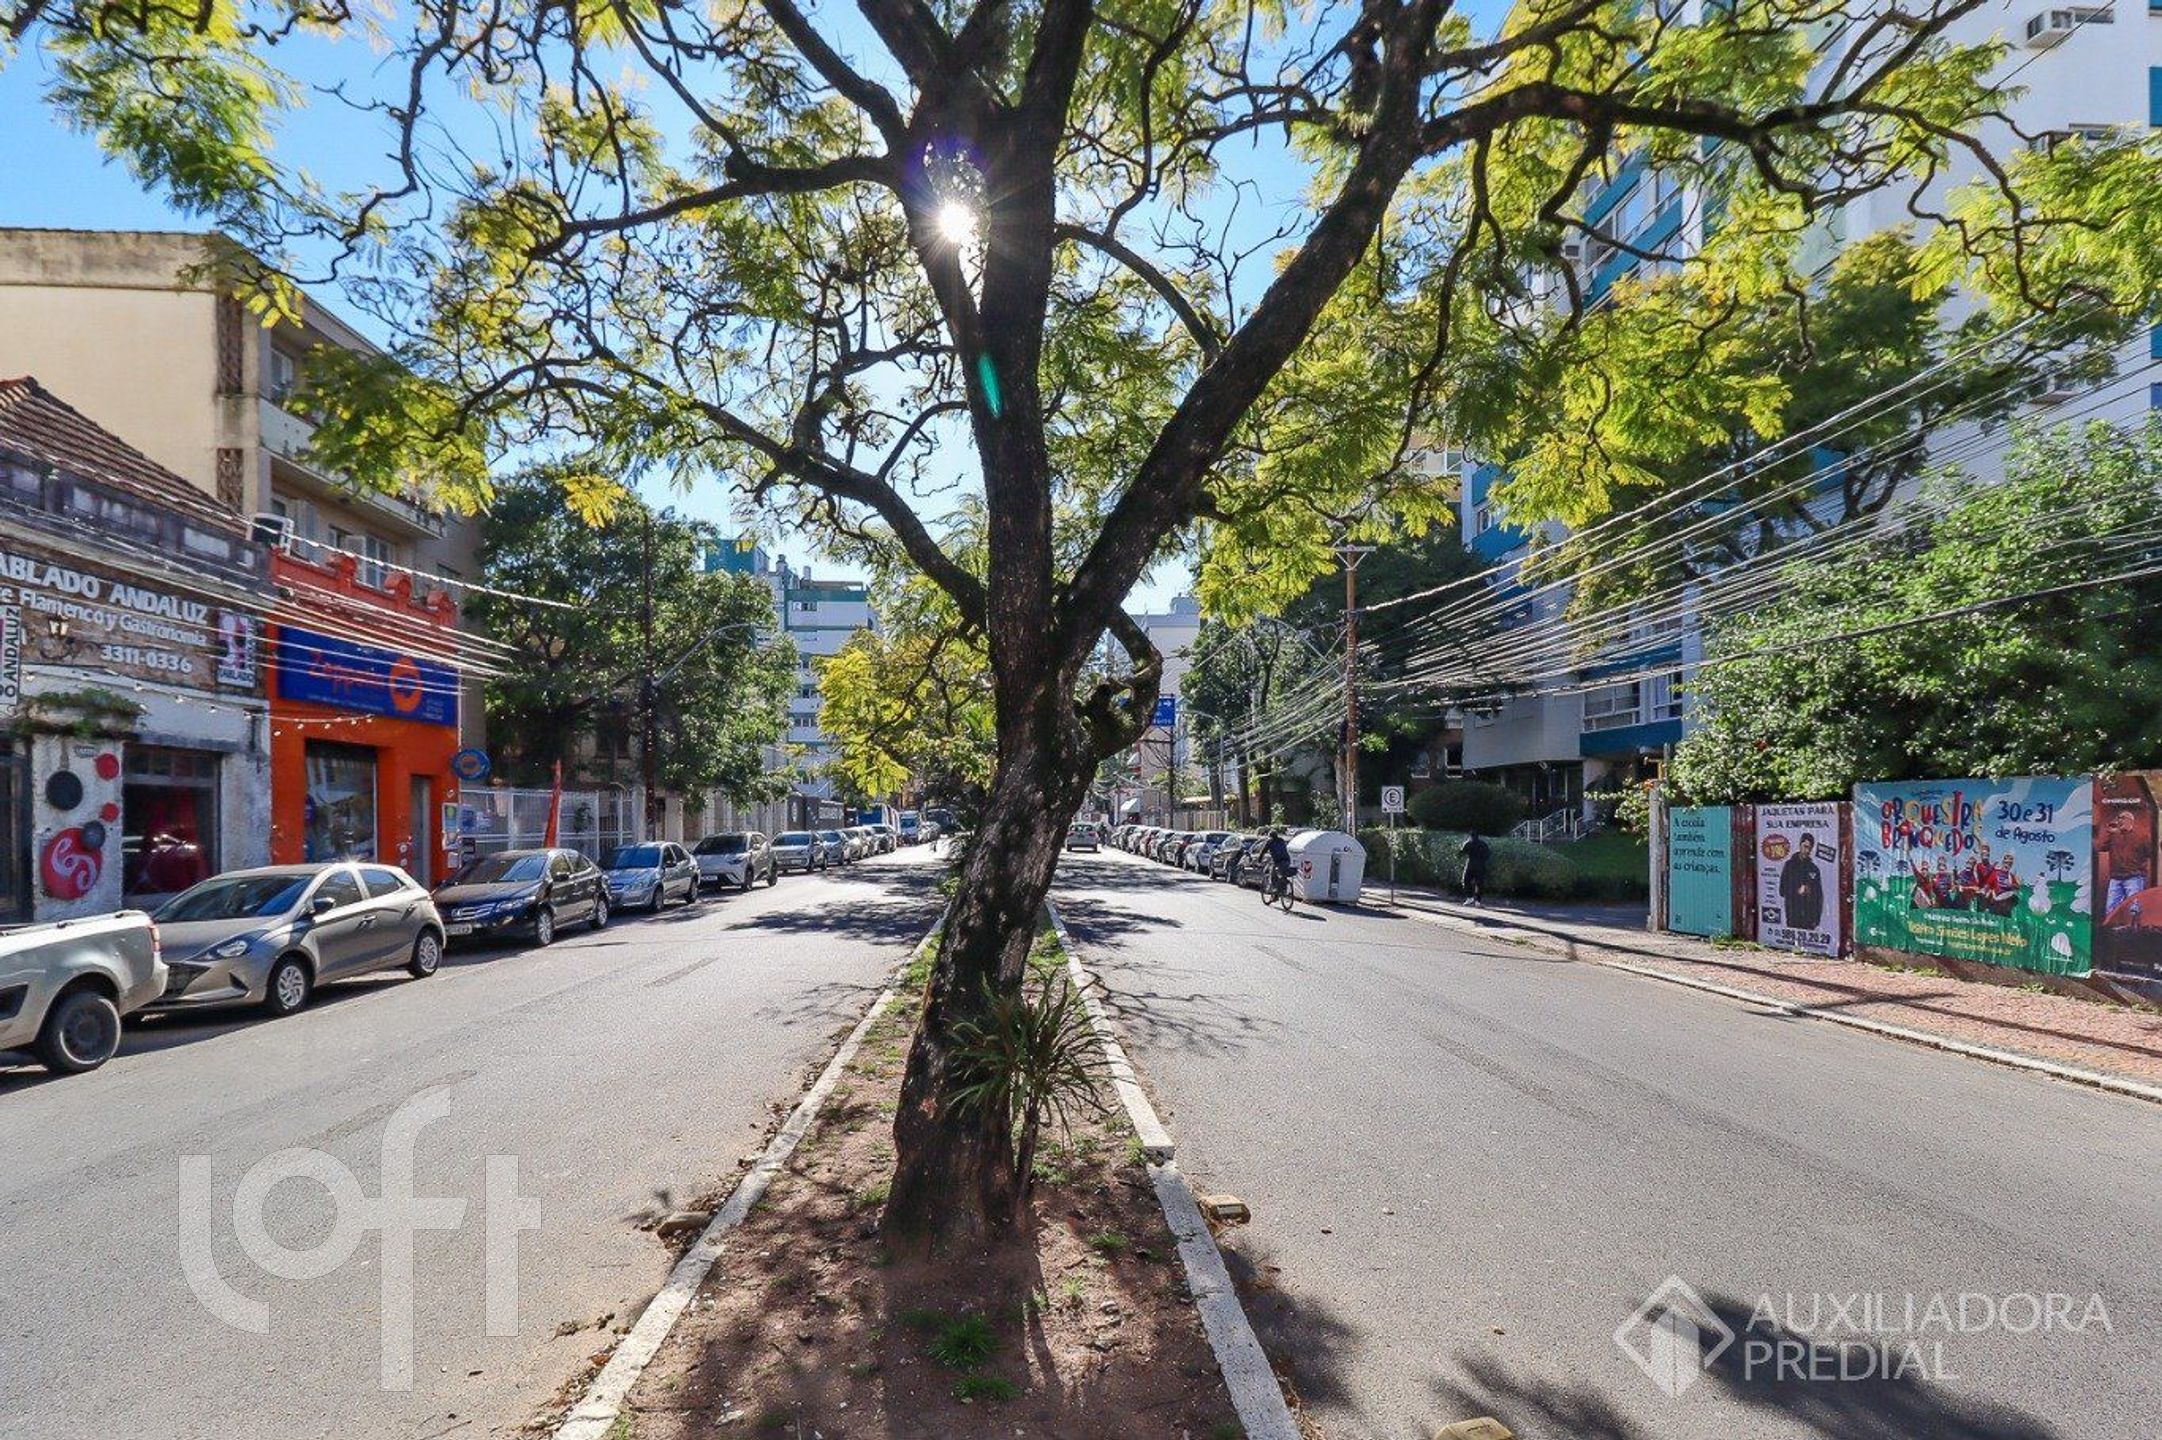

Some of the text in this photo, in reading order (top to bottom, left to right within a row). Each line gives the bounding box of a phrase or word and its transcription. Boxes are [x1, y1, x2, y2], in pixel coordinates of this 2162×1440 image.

[20, 588, 104, 624] Flamenco
[105, 612, 118, 632] y
[109, 583, 207, 625] ANDALUZ
[3, 606, 20, 682] ANDALUZ
[100, 644, 193, 674] 3311-0336
[1761, 805, 1835, 817] JAQUETAS PARA
[1766, 819, 1830, 829] SUA EMPRESA
[1997, 800, 2053, 824] 30 e 31
[1995, 825, 2056, 844] de Agosto
